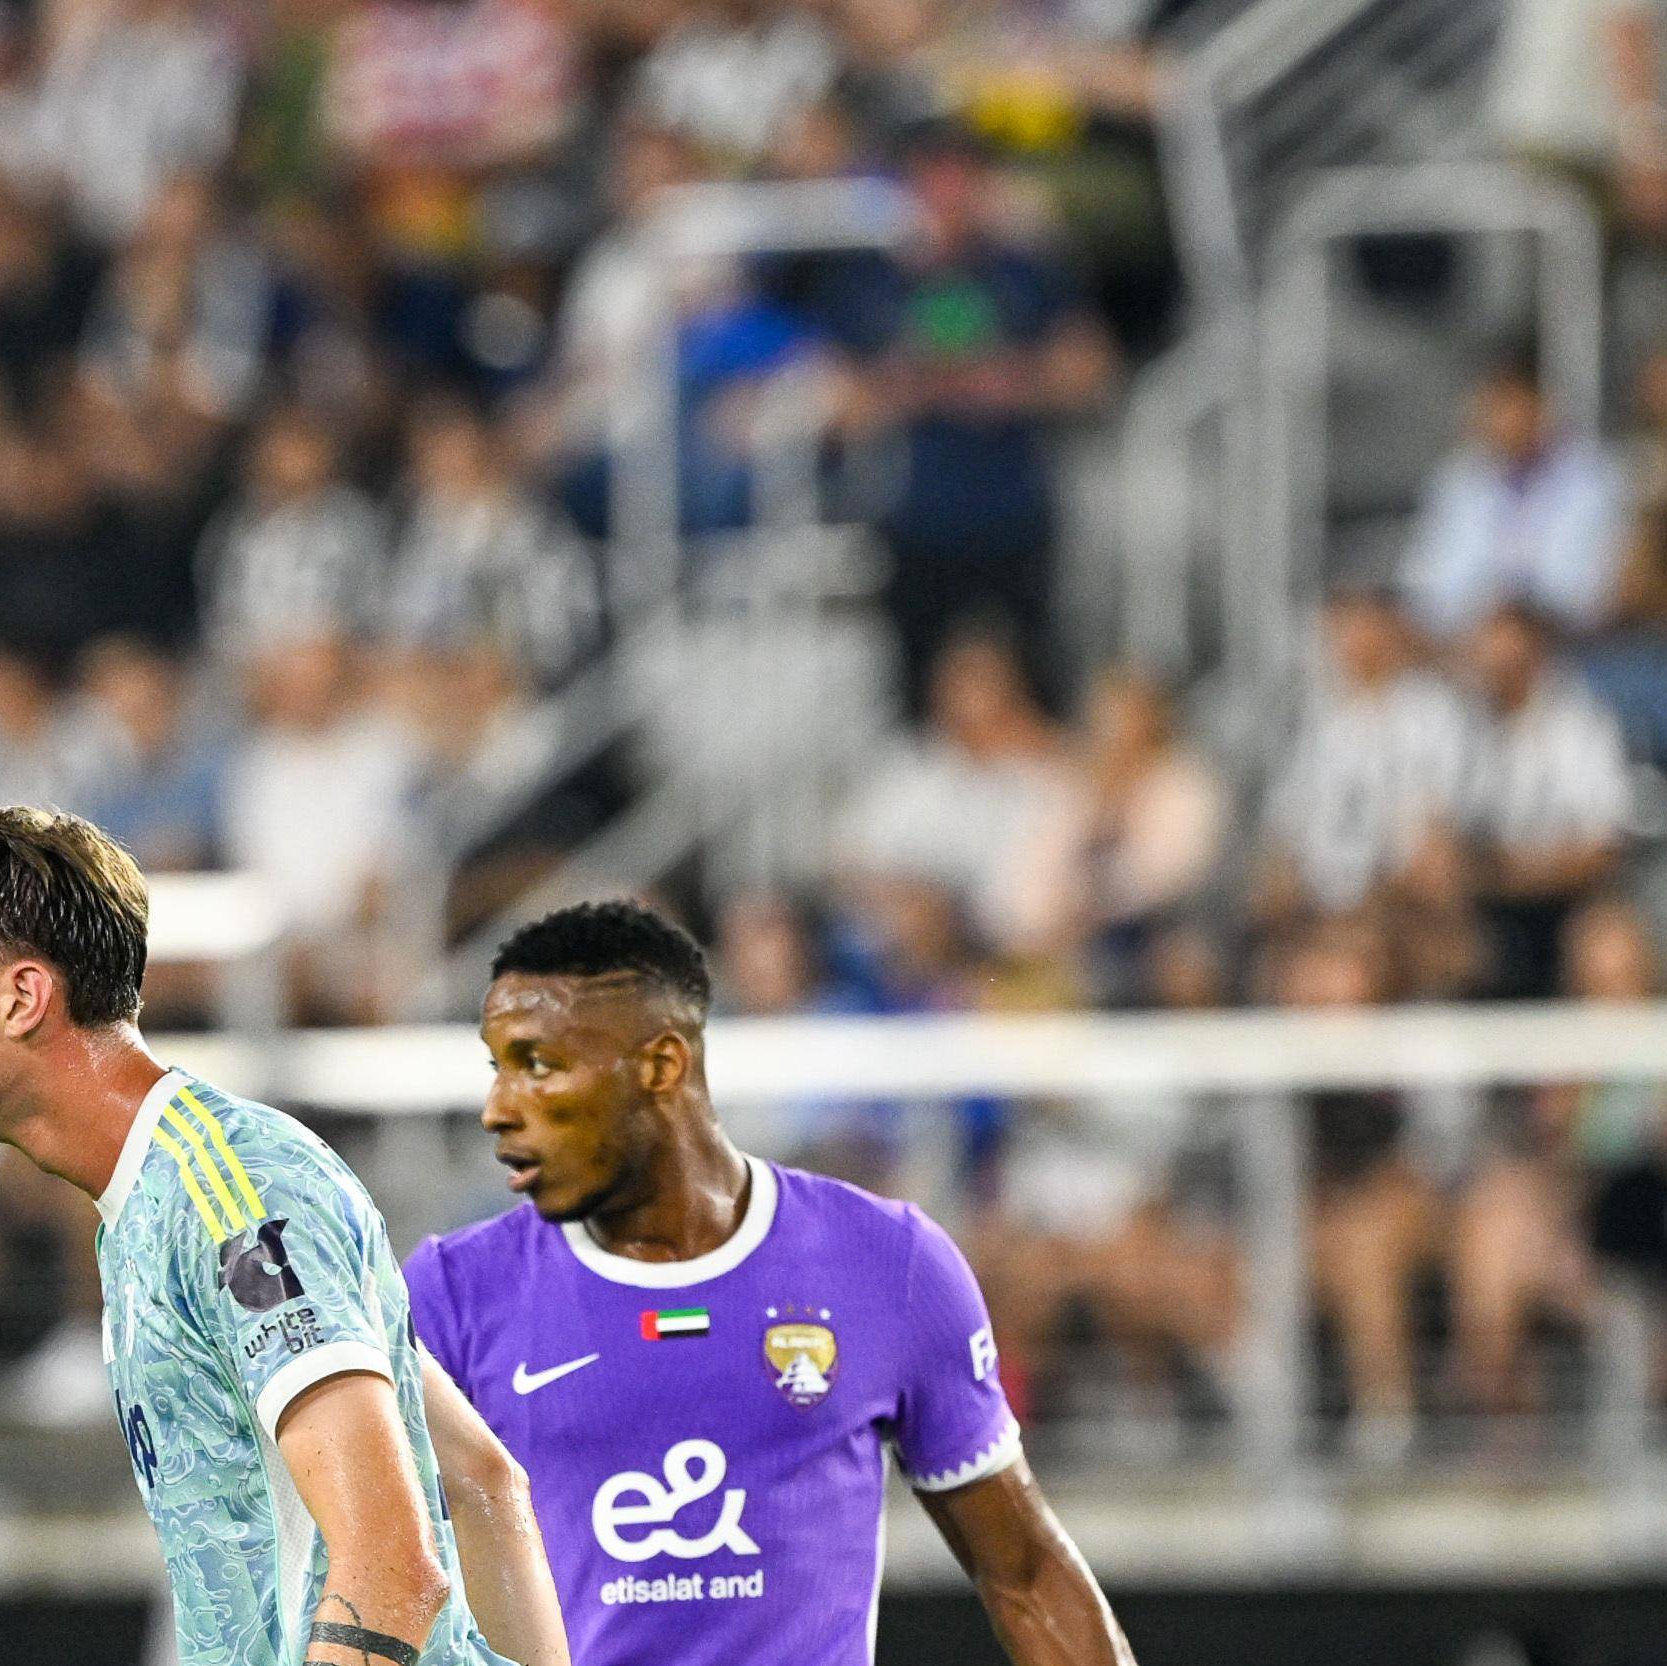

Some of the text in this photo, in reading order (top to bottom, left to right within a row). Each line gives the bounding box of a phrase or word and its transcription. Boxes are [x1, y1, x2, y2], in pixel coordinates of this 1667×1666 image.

[244, 1308, 316, 1358] white
[280, 1320, 324, 1354] bit
[600, 1569, 764, 1605] etisalat and
